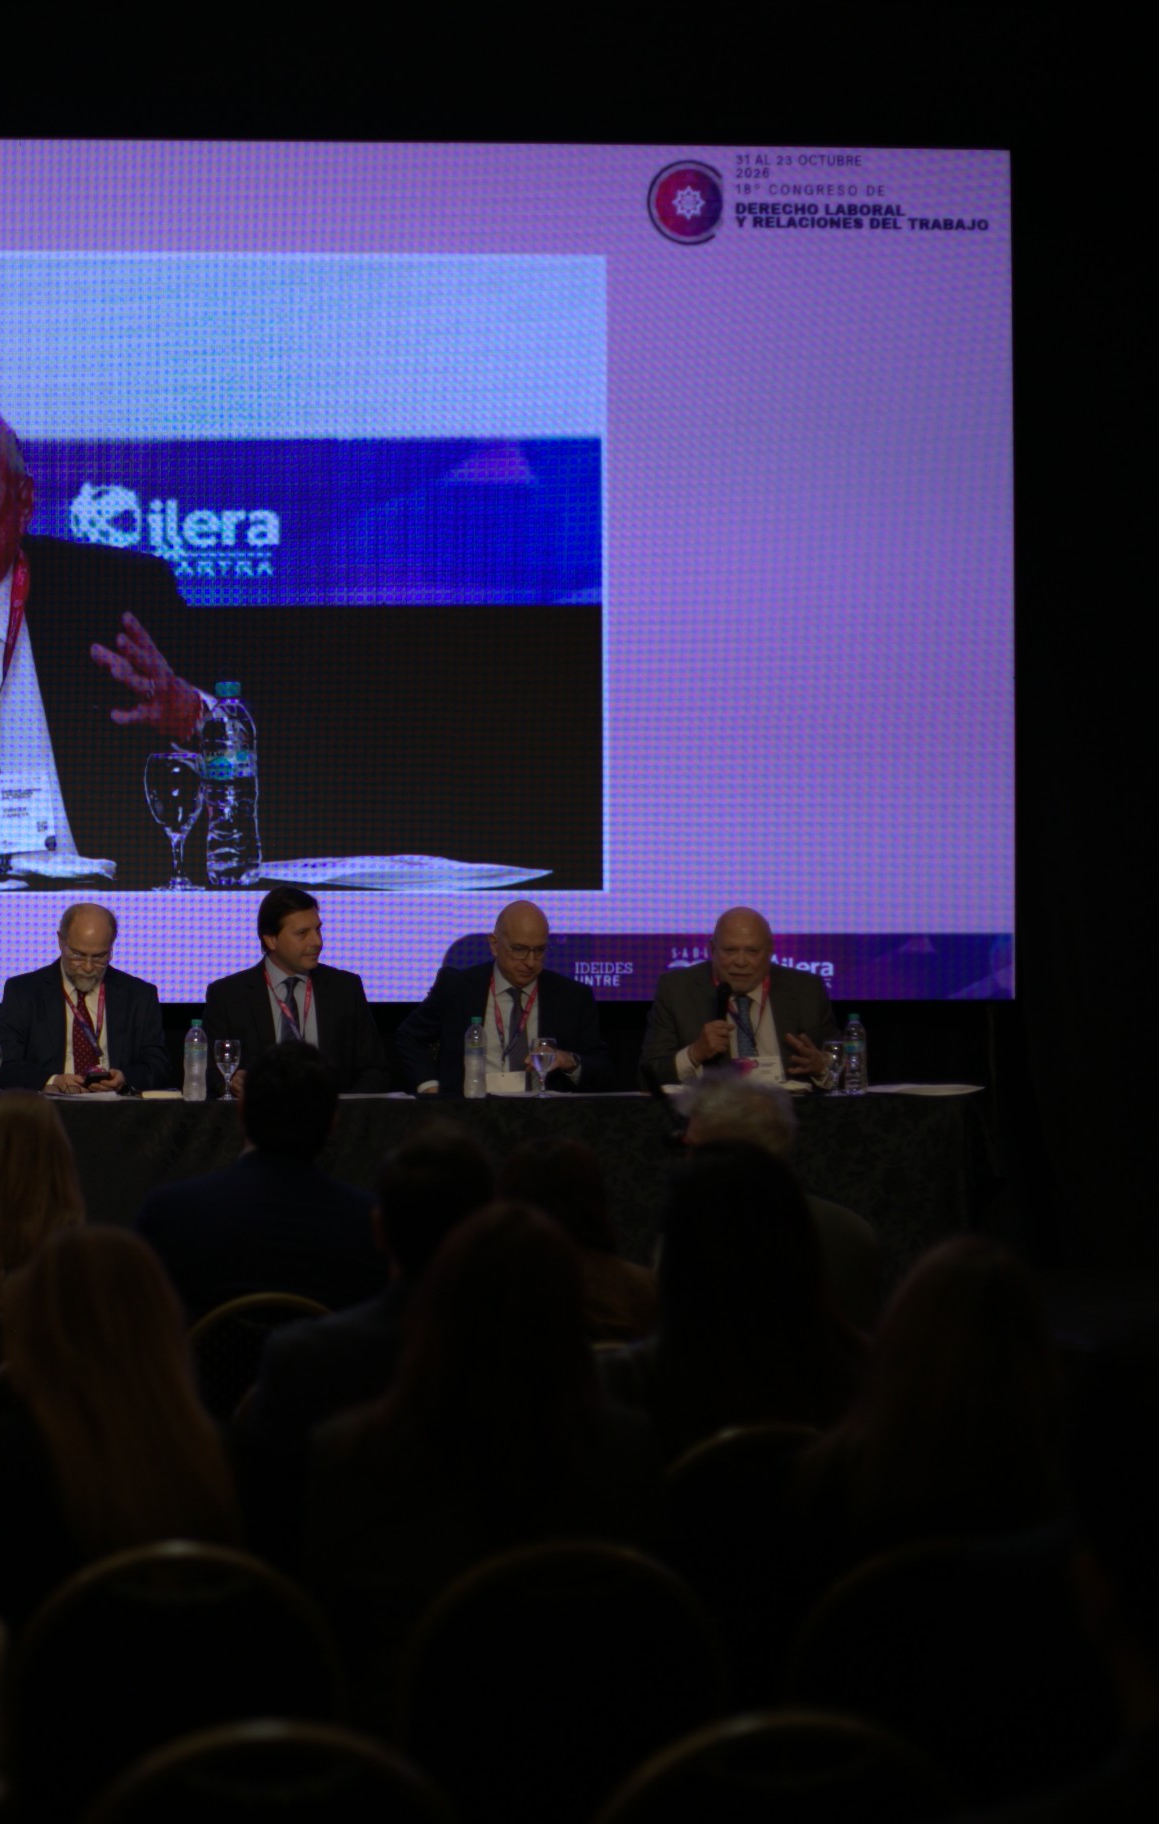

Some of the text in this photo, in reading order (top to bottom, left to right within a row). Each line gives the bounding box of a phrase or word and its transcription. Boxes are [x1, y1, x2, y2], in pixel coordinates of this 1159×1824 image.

[755, 154, 770, 165] AL
[798, 155, 862, 166] OCTUBRE
[769, 184, 858, 196] CONGRESO
[866, 185, 885, 197] DE
[735, 203, 905, 216] DERECHO LABORAL
[735, 216, 989, 231] Y RELACIONES DEL TRABAJO
[575, 961, 633, 974] IDEIDES
